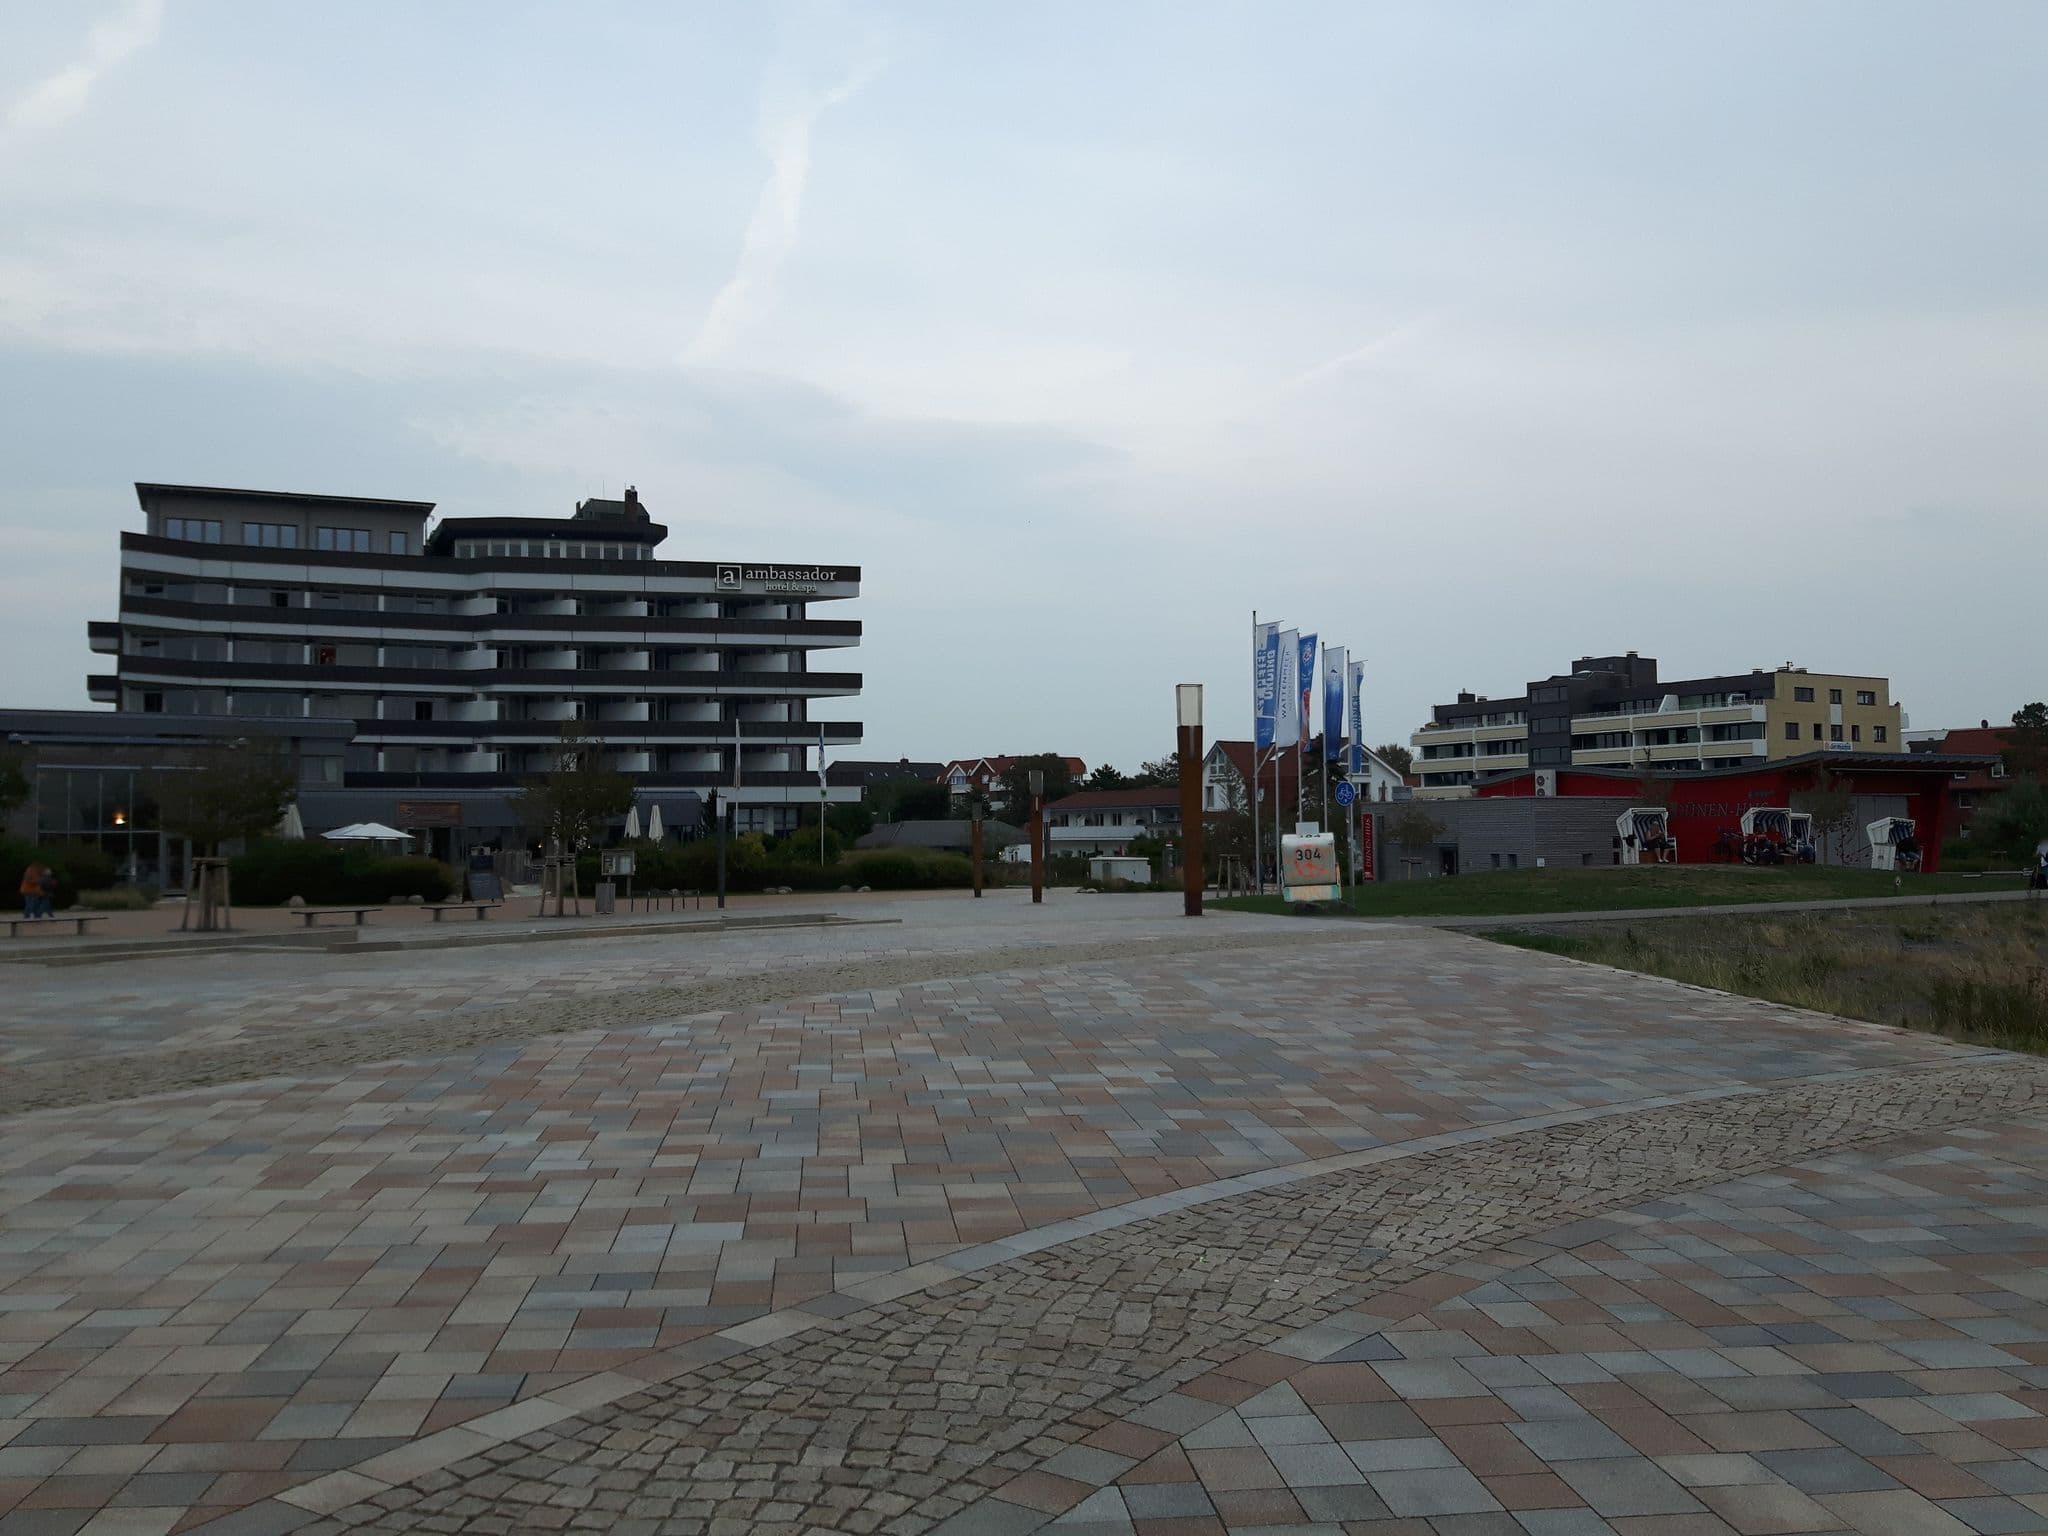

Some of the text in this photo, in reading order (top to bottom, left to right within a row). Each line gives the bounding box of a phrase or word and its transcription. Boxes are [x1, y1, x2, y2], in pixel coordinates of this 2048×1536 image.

[723, 569, 736, 584] a
[745, 566, 837, 581] ambassador
[765, 581, 817, 594] hotel & spa
[1295, 848, 1321, 862] 304
